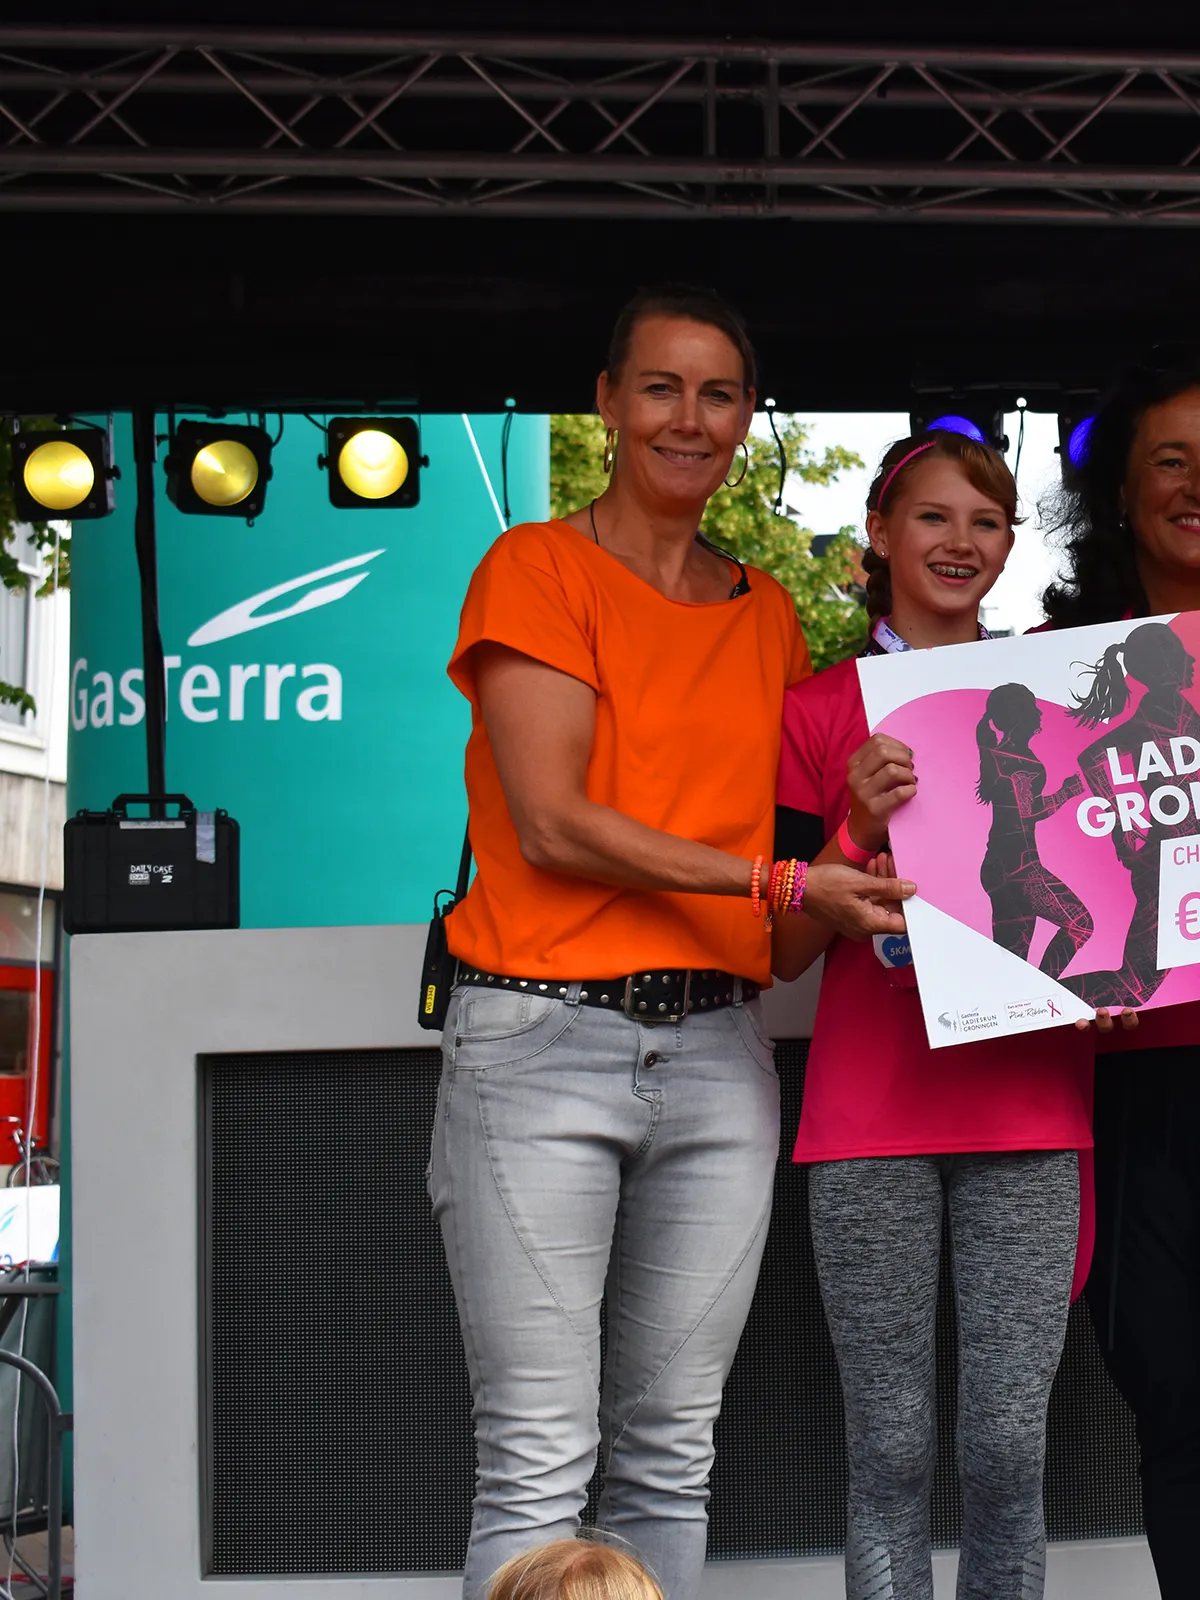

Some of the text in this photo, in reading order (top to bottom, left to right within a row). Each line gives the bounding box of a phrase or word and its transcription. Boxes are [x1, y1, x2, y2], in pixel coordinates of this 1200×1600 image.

[130, 864, 174, 875] DAILY CASE
[161, 874, 173, 883] 2
[890, 945, 911, 957] 5KM
[1008, 1006, 1048, 1020] Pink Ribbon
[961, 1014, 997, 1026] LADIESRUN
[962, 1021, 998, 1033] GRONINGEN
